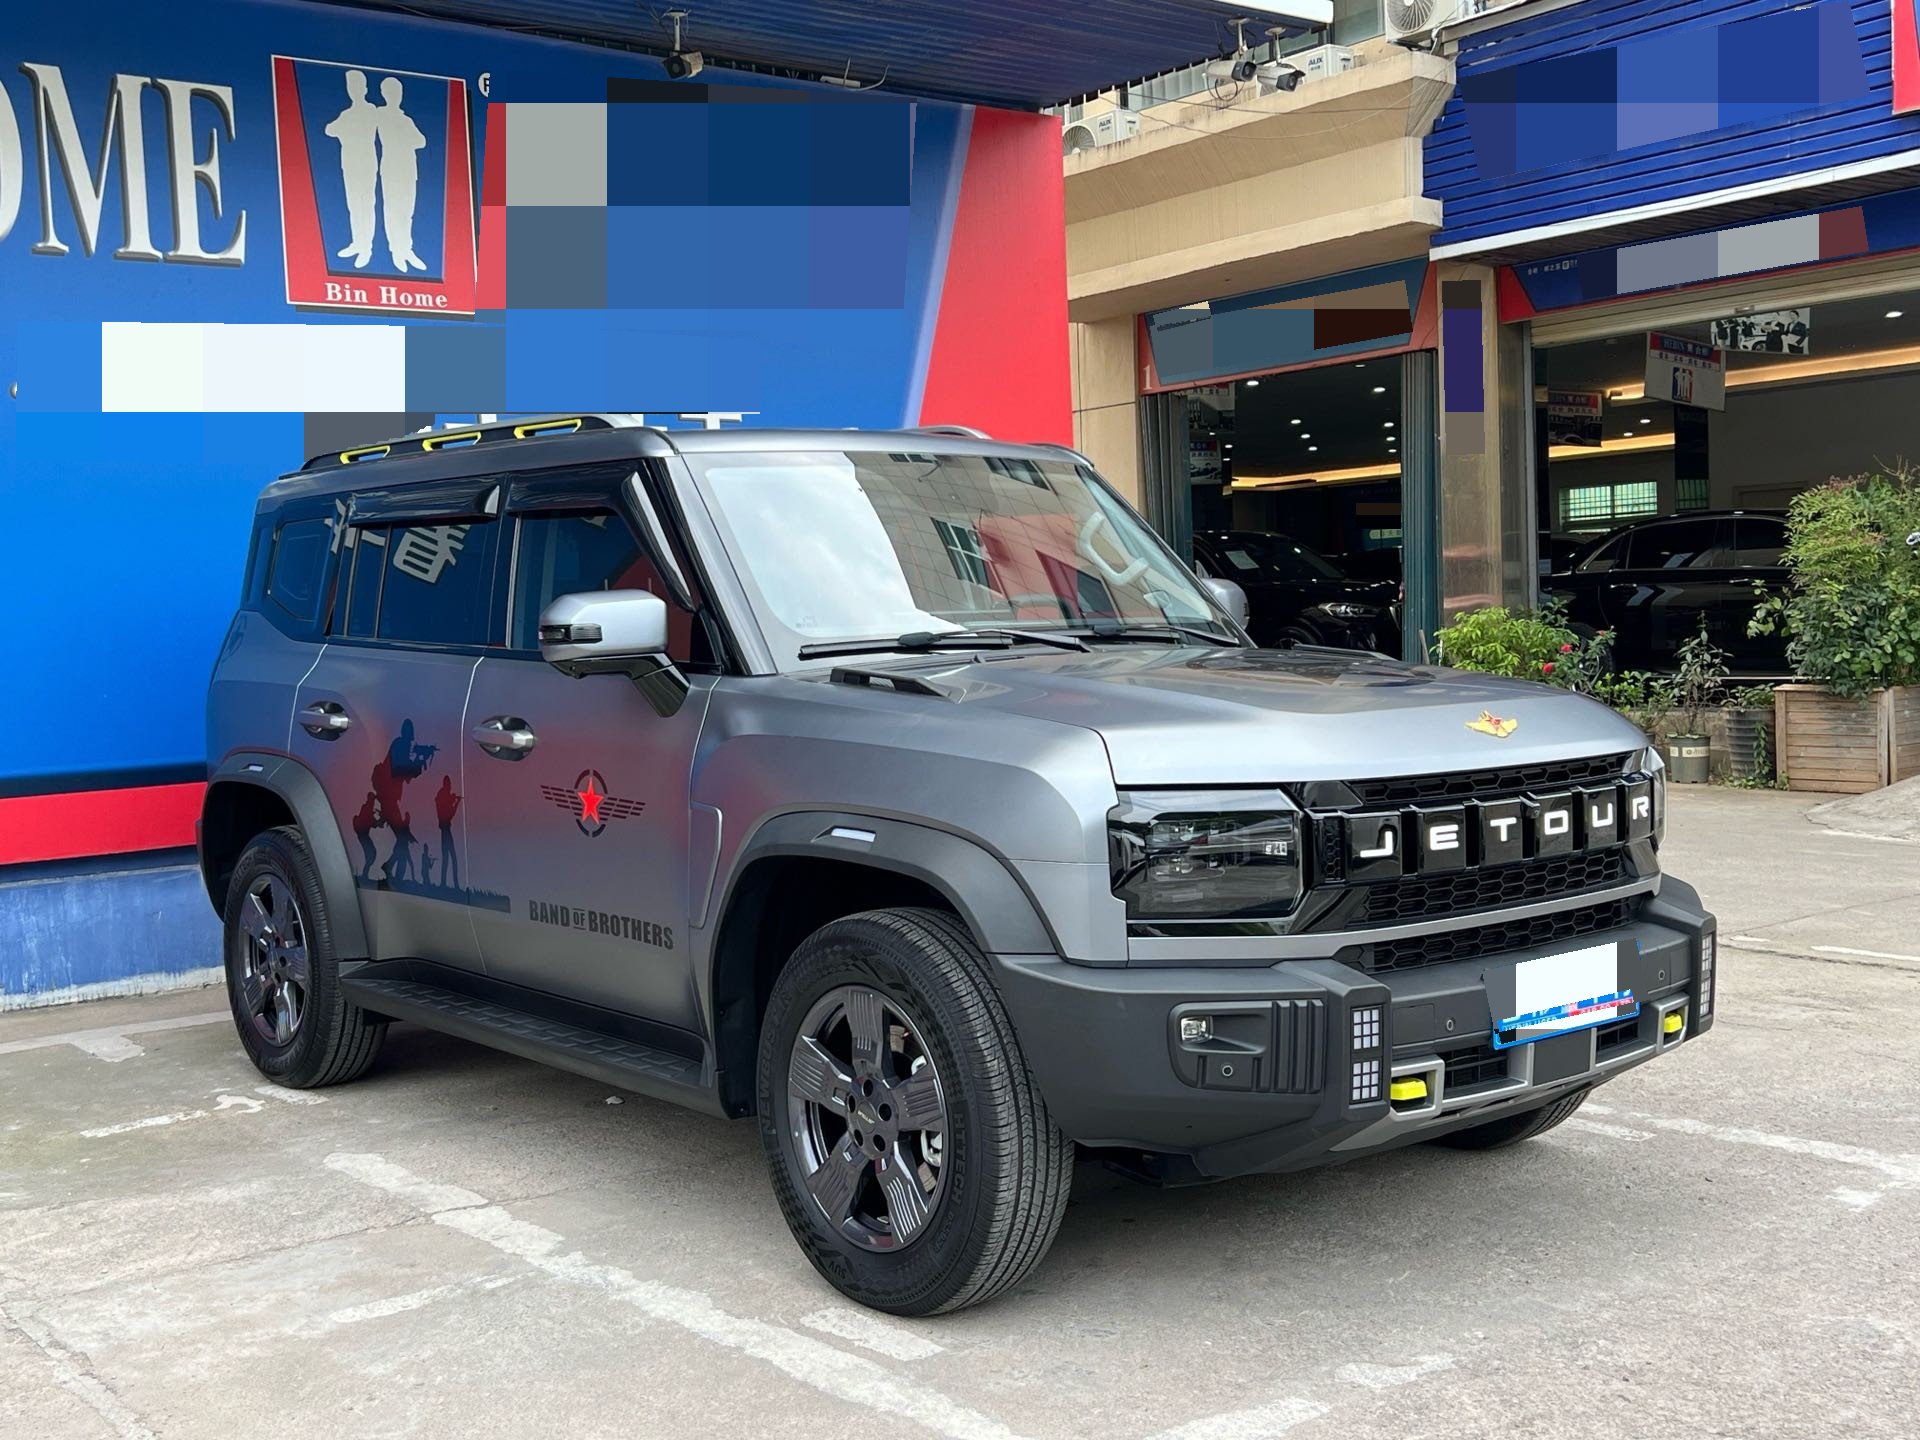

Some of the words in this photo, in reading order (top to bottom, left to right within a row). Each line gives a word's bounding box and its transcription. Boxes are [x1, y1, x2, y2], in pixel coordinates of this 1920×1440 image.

[0, 61, 247, 267] ME
[324, 281, 368, 306] Bin
[380, 286, 449, 309] Home
[1143, 364, 1153, 391] 1
[1359, 795, 1651, 859] JETOUR
[529, 900, 570, 927] BAND
[572, 908, 586, 930] OF
[588, 911, 673, 950] BROTHERS
[829, 1260, 847, 1280] SUV
